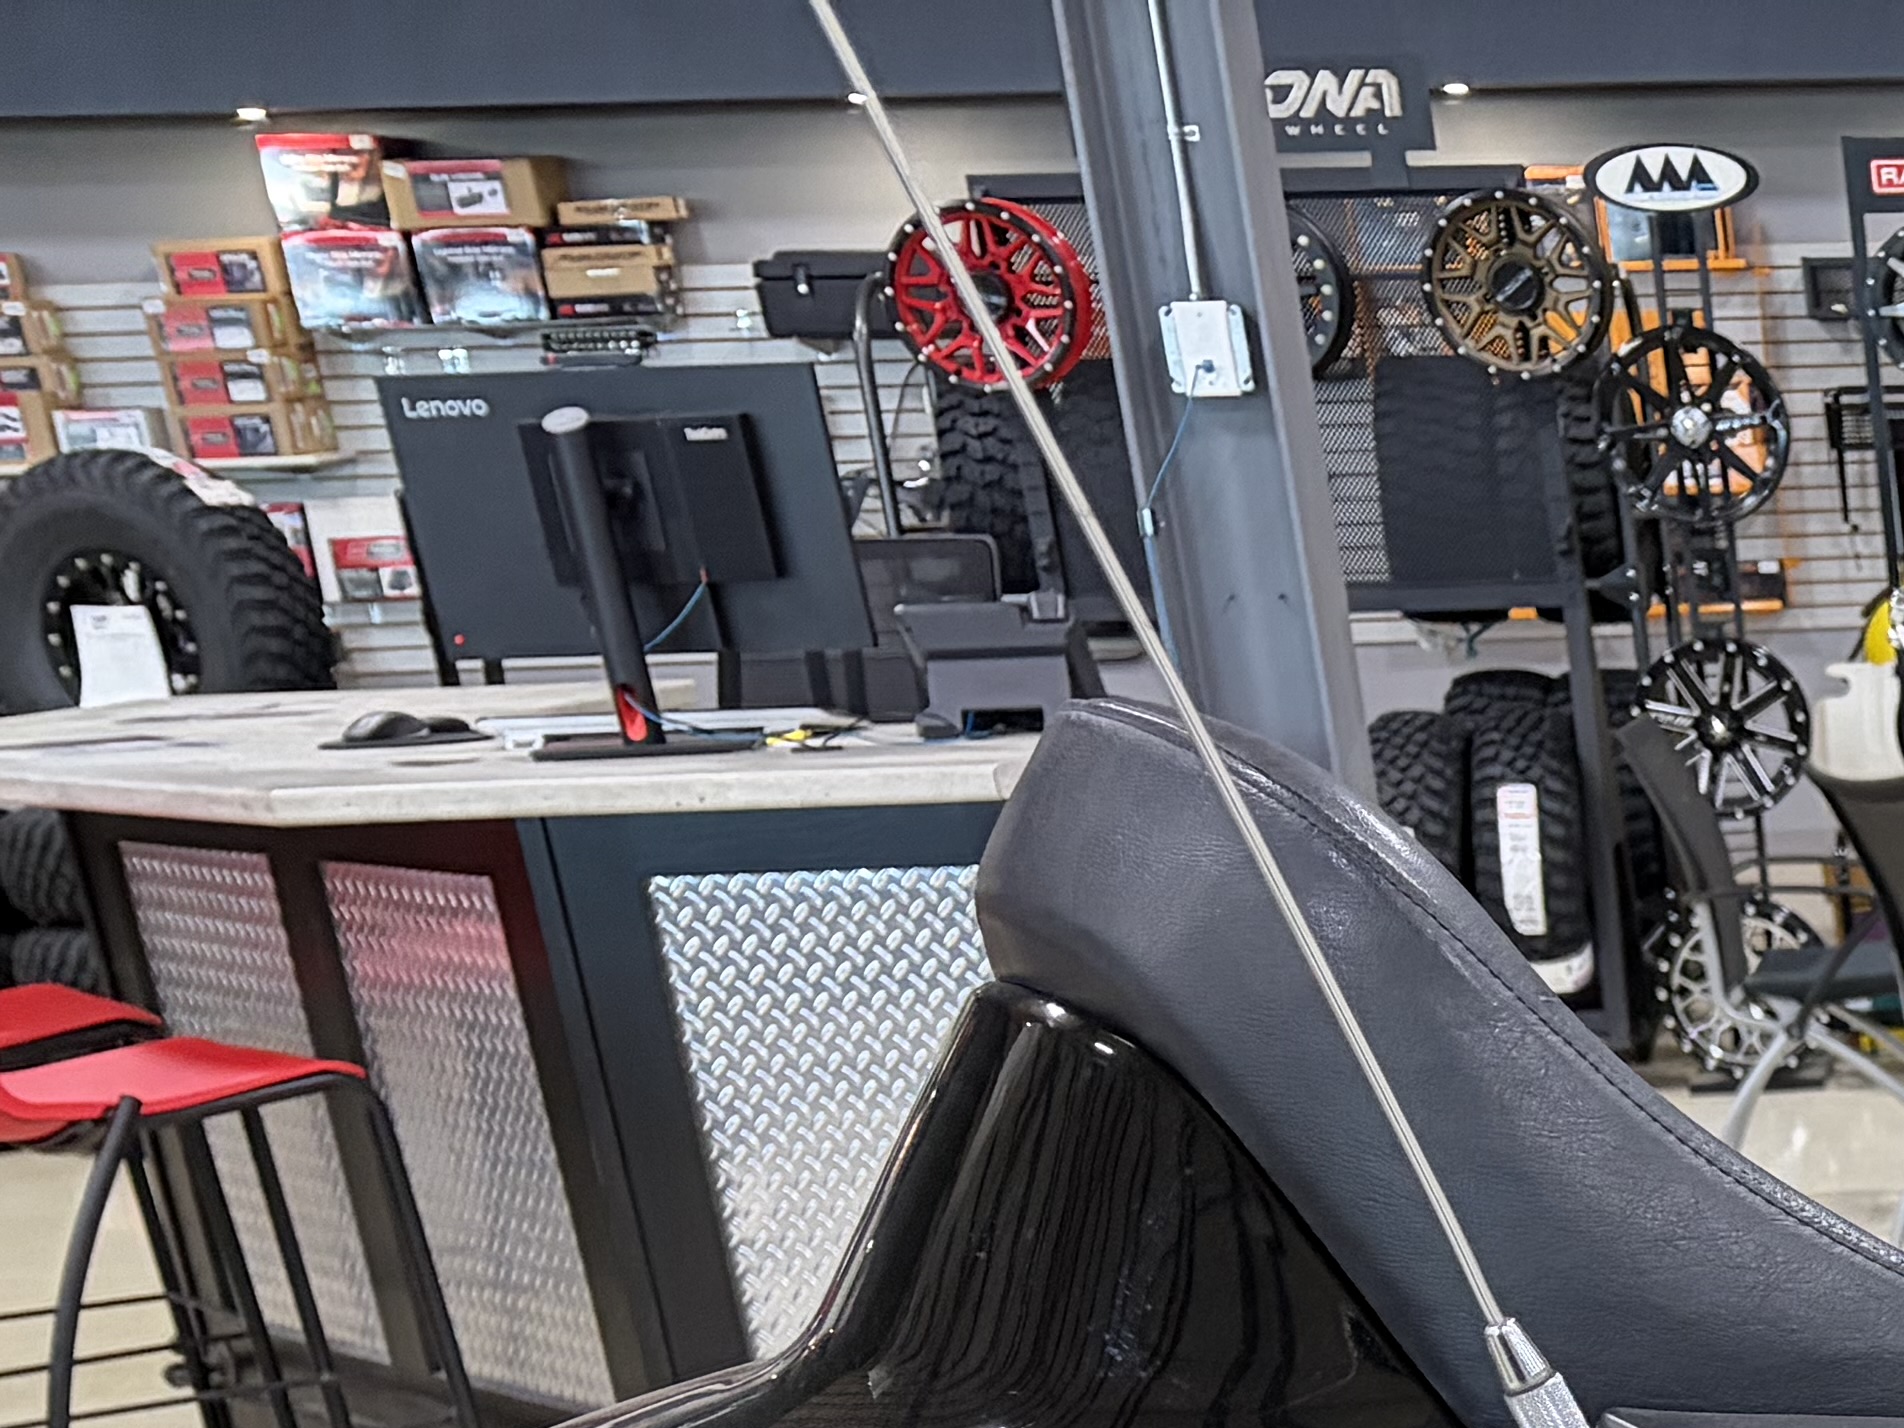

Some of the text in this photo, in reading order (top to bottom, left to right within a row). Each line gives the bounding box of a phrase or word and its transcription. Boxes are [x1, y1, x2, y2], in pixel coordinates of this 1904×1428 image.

[1264, 69, 1402, 118] DNA
[1285, 123, 1389, 136] WHEEL
[401, 397, 490, 419] Lenovo
